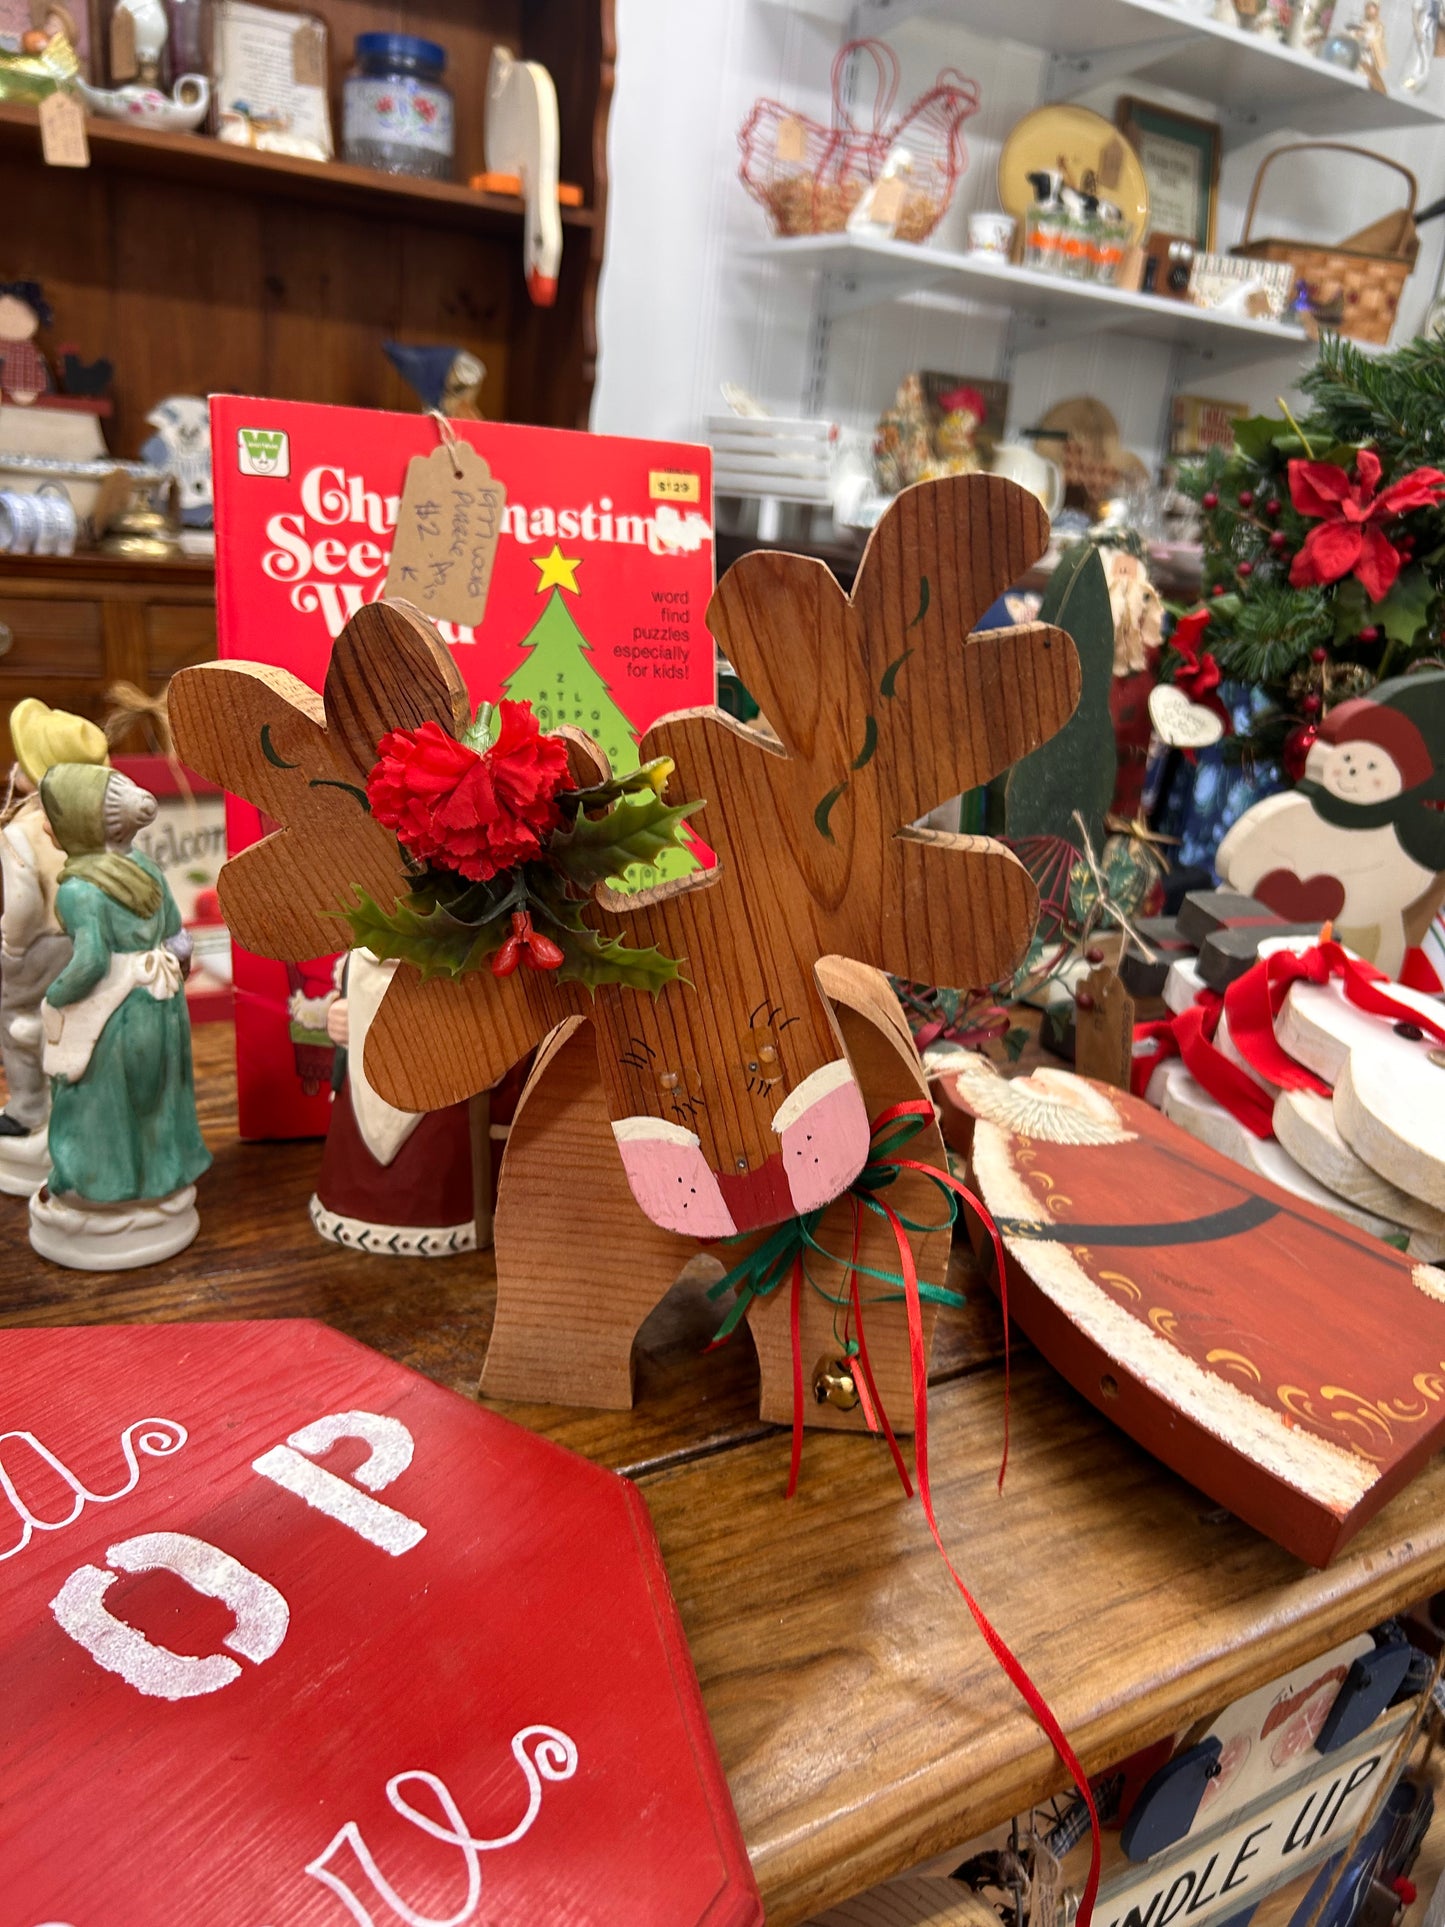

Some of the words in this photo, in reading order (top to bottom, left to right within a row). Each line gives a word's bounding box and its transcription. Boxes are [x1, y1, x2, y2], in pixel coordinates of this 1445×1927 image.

[475, 488, 499, 540] 1977
[651, 591, 688, 604] word
[661, 607, 689, 623] find
[633, 627, 689, 642] puzzles
[613, 645, 690, 664] especially
[627, 662, 648, 677] for
[653, 664, 689, 680] kids!
[1110, 1823, 1272, 1927] NDLE
[1281, 1755, 1381, 1854] UP
